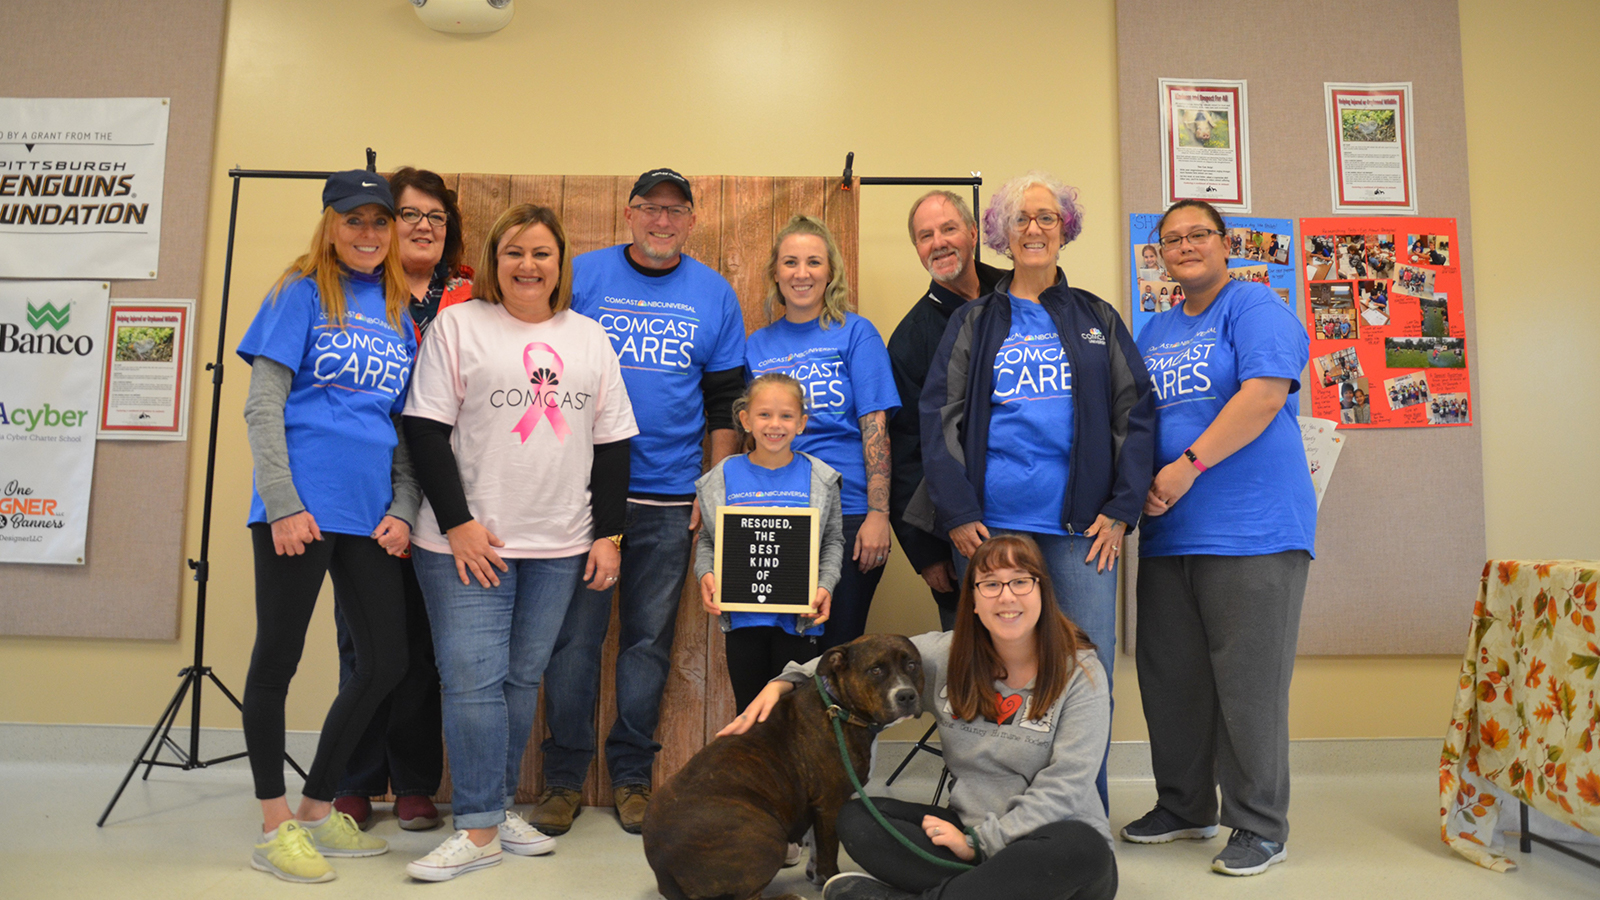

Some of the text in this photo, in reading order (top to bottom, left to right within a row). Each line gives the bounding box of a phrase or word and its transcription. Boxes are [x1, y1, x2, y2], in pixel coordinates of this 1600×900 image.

[7, 131, 19, 140] BY
[22, 132, 28, 140] A
[31, 132, 62, 140] GRANT
[65, 132, 91, 140] FROM
[95, 132, 113, 141] THE
[0, 161, 127, 171] PITTSBURGH
[0, 174, 136, 197] ENGUINS
[604, 296, 697, 313] COMCAST NBCUNIVERSAL
[599, 314, 699, 340] COMCAST
[758, 357, 788, 367] COMCAST
[1144, 344, 1215, 371] OMCAST
[994, 362, 1072, 397] CARE
[1150, 362, 1211, 401] ARES
[490, 388, 591, 410] COMCAST
[6, 433, 27, 441] Cyber
[59, 435, 82, 443] School
[4, 479, 34, 496] One
[728, 492, 756, 500] COMCAST
[0, 497, 57, 516] GNER
[10, 512, 66, 529] Banners
[741, 518, 792, 529] RESCUED.
[754, 531, 776, 542] THE
[749, 544, 780, 555] BEST
[749, 557, 779, 568] KIND
[756, 571, 770, 581] OF
[751, 583, 773, 594] DOG
[960, 724, 987, 738] County
